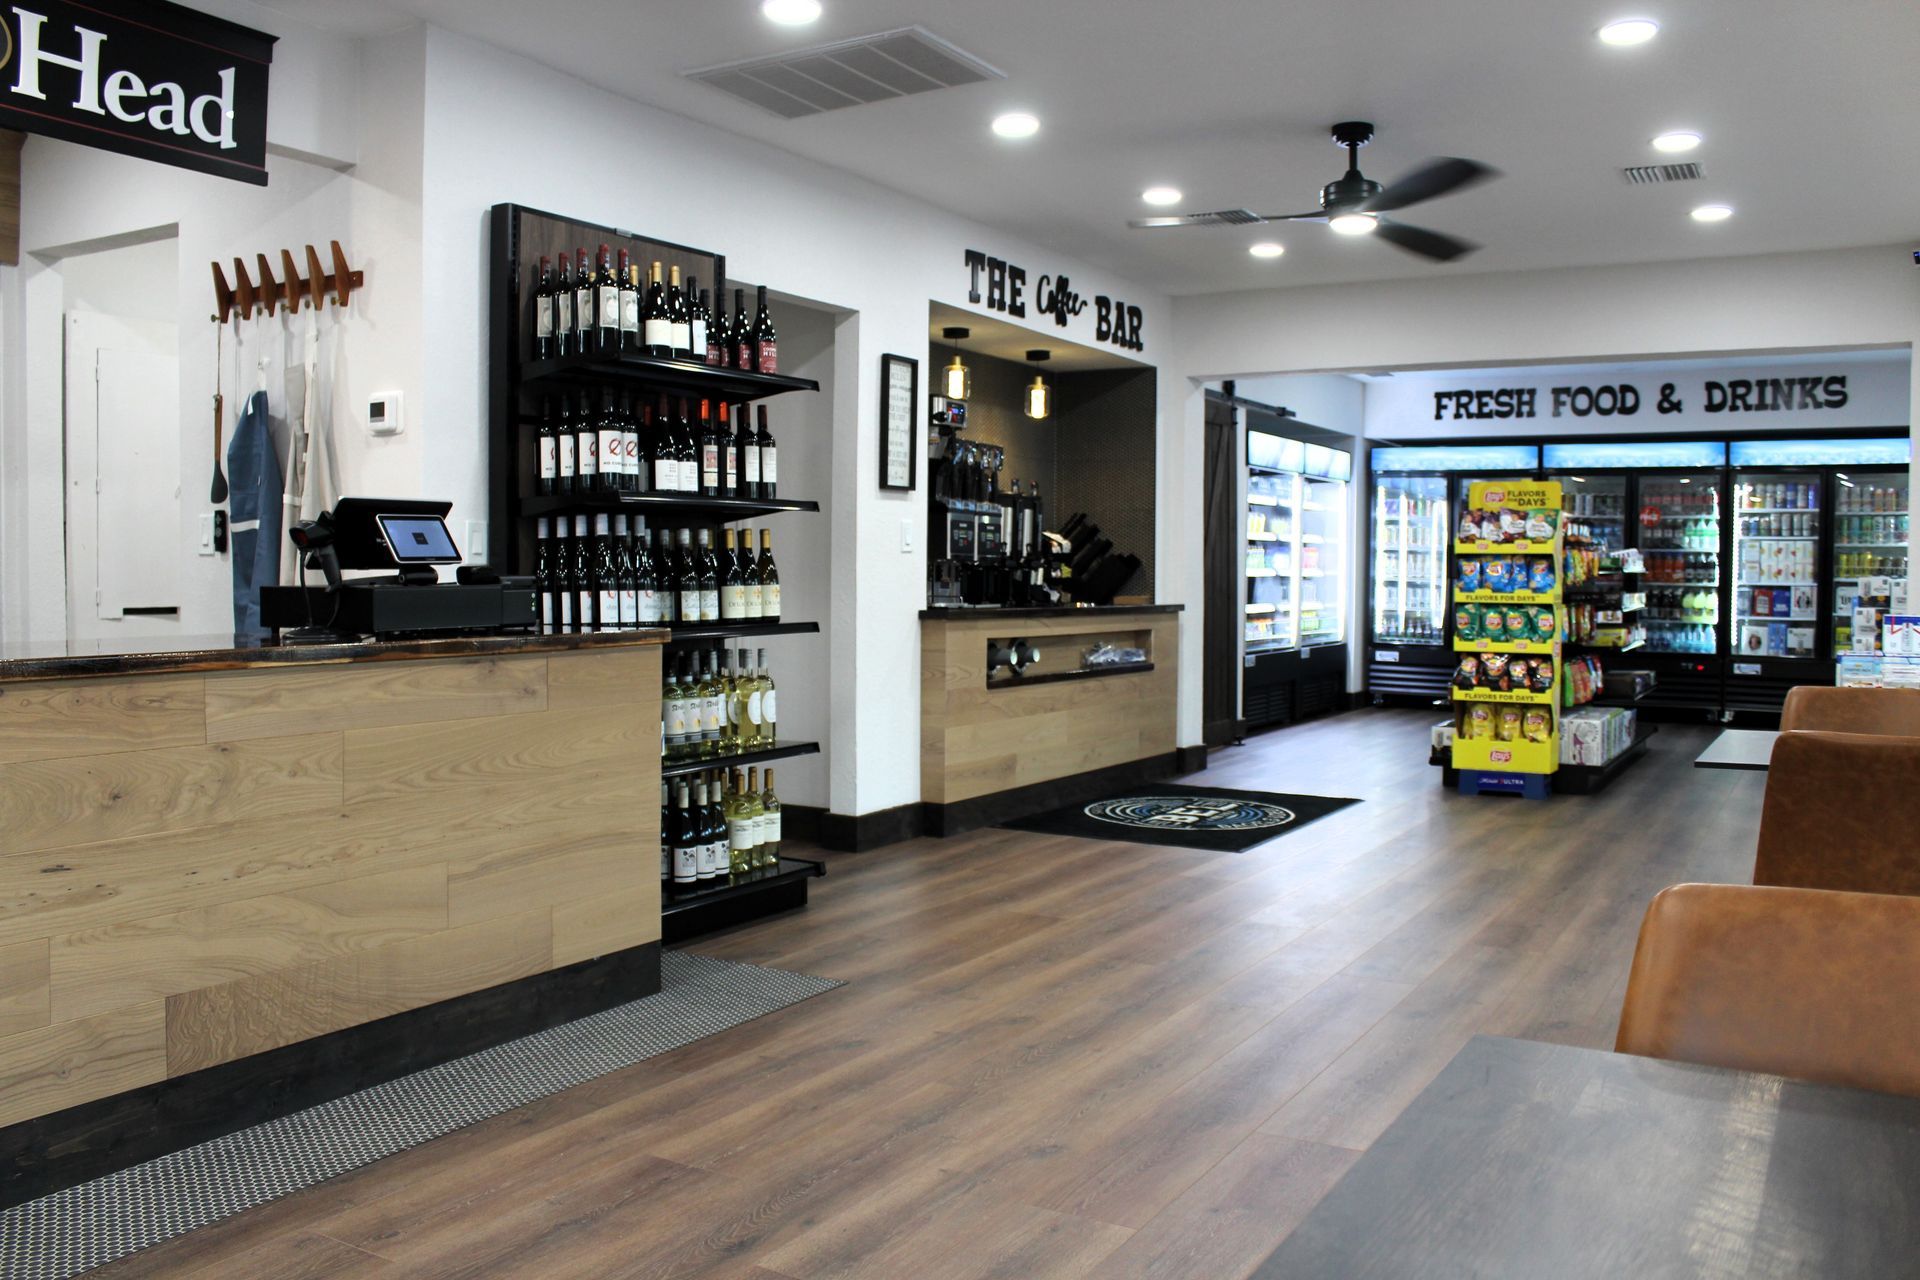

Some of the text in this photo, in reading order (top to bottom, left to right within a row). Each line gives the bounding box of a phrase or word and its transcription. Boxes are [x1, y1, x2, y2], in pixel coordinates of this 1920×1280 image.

[11, 6, 238, 150] Head
[965, 249, 1143, 352] THE Coffee BAR
[1434, 376, 1848, 420] FRESH FOOD & DRINKS
